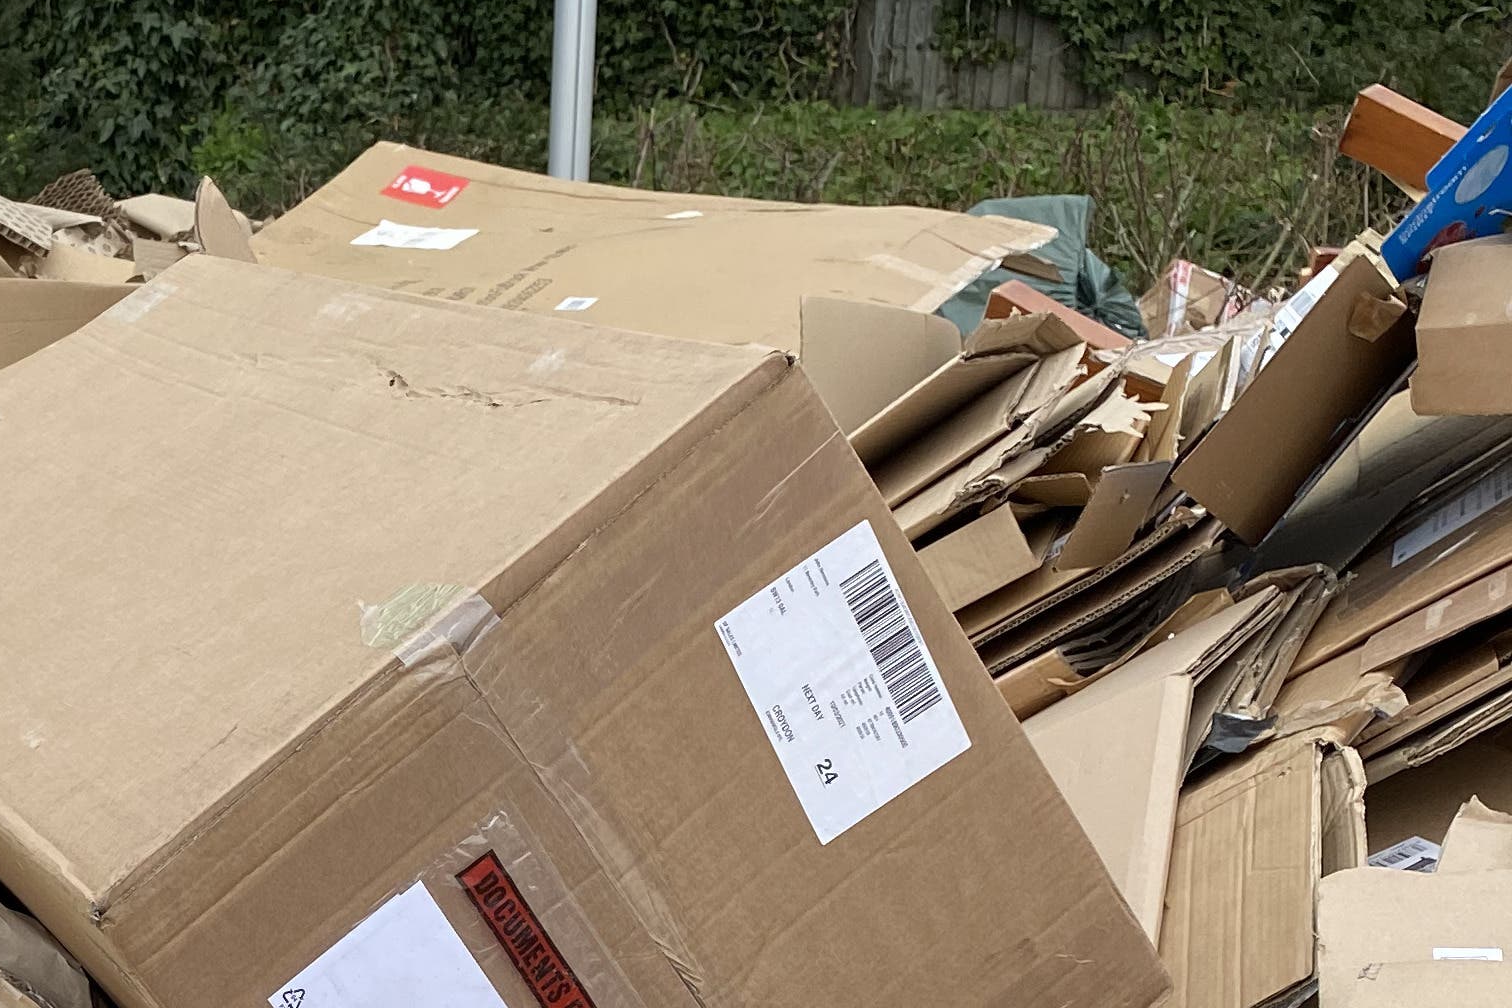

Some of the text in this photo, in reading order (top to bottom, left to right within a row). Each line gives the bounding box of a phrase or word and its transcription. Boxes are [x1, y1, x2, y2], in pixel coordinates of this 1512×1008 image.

[802, 684, 824, 720] NEXT DAY
[772, 705, 794, 742] CROYDON
[817, 759, 838, 784] 24
[473, 870, 571, 1003] DOCUMENTS
